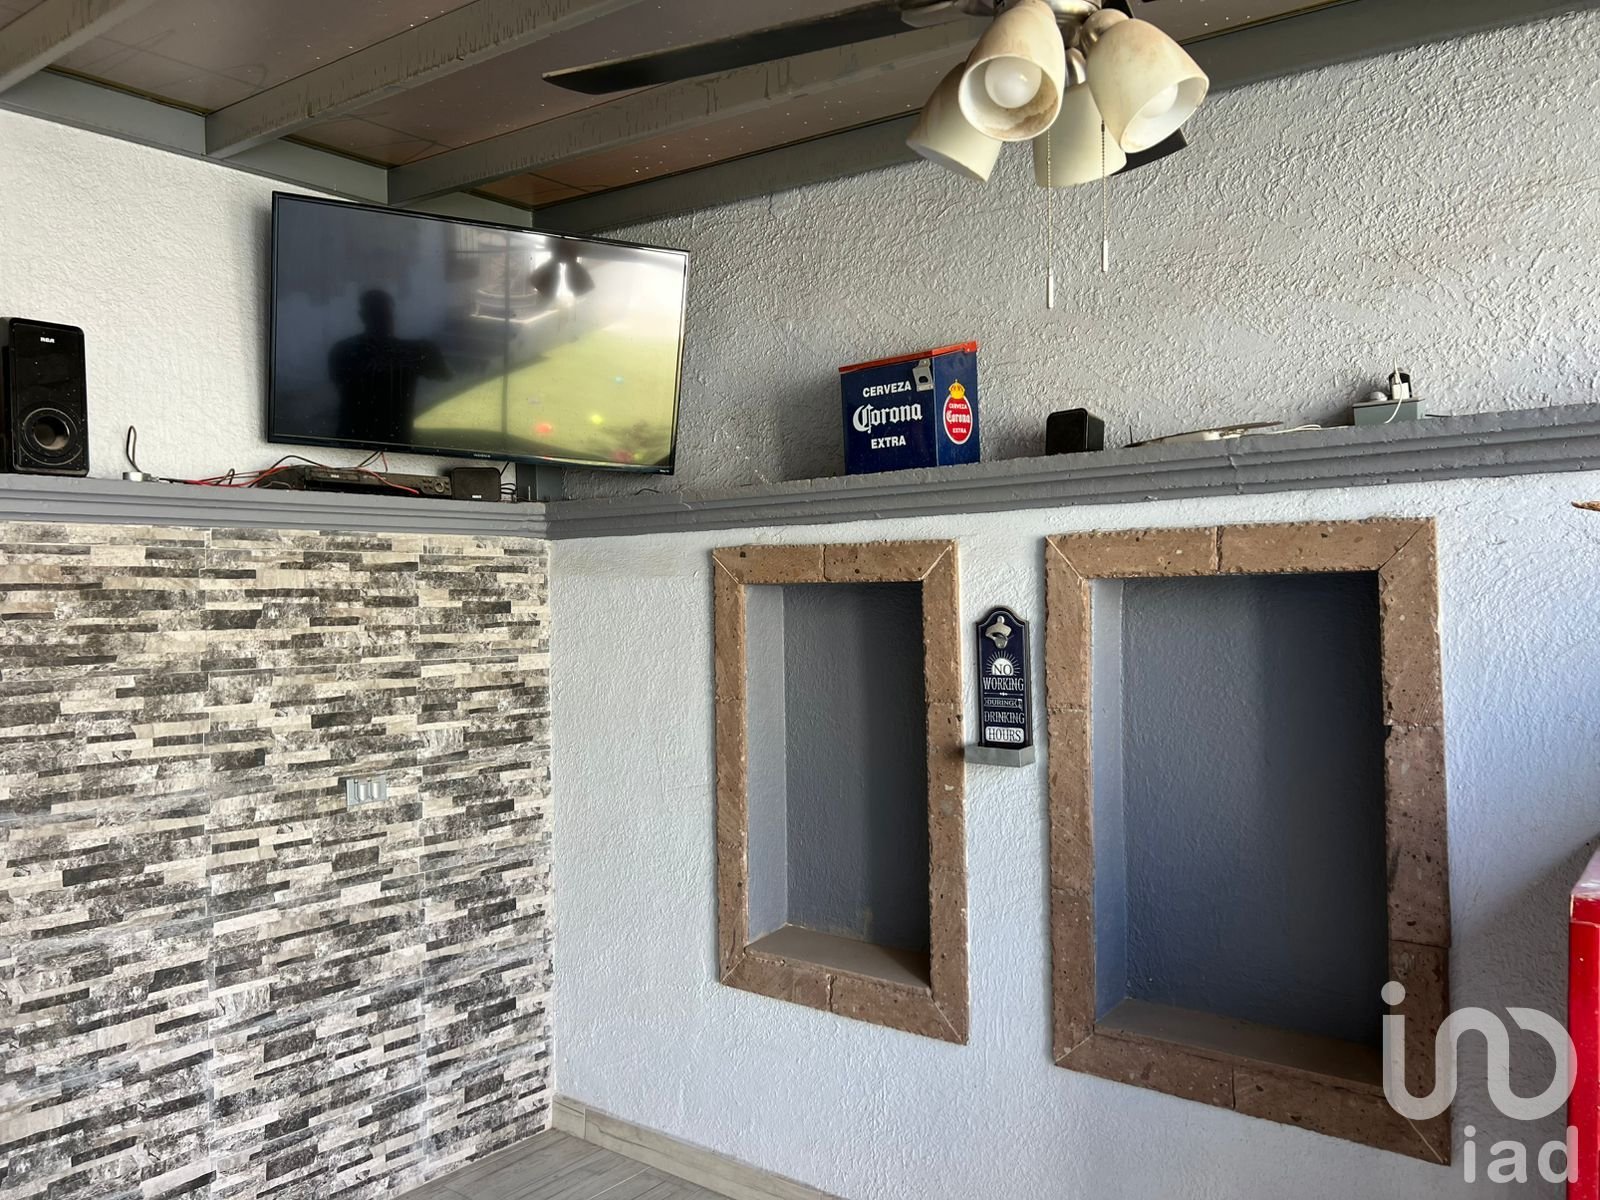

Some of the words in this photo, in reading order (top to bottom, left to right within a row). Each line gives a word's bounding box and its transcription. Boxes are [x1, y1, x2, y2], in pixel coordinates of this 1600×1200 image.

[862, 381, 912, 398] CERVEZA
[852, 403, 923, 434] Corona
[946, 410, 970, 424] Corona
[870, 435, 906, 450] EXTRA
[993, 663, 1013, 676] NO
[982, 677, 1024, 691] WORKING
[987, 699, 1015, 707] DURING
[984, 711, 1025, 724] DRINKING
[988, 727, 1022, 742] HOURS
